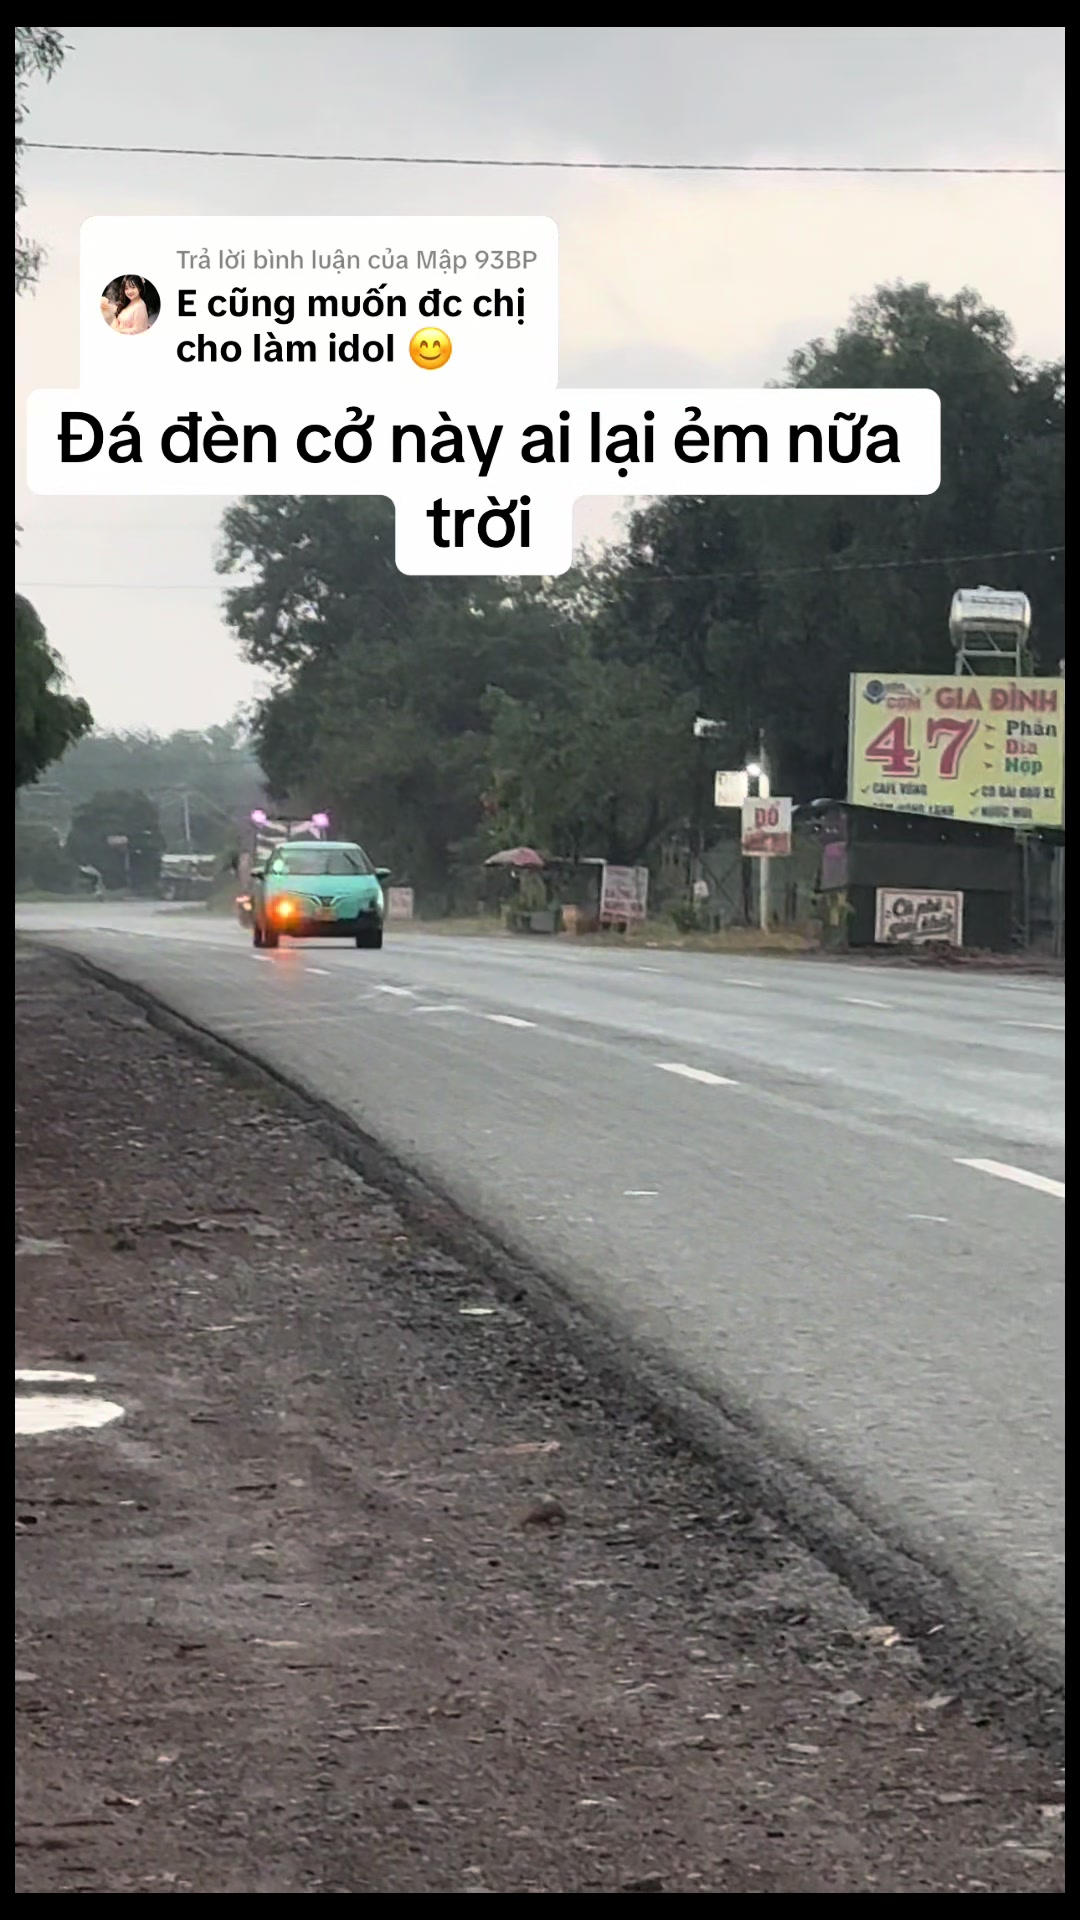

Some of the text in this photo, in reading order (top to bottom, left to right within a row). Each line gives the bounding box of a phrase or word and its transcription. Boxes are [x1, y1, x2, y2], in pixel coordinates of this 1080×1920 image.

[935, 686, 982, 711] GIA
[990, 682, 1058, 712] ĐÌNH
[865, 716, 980, 779] 47
